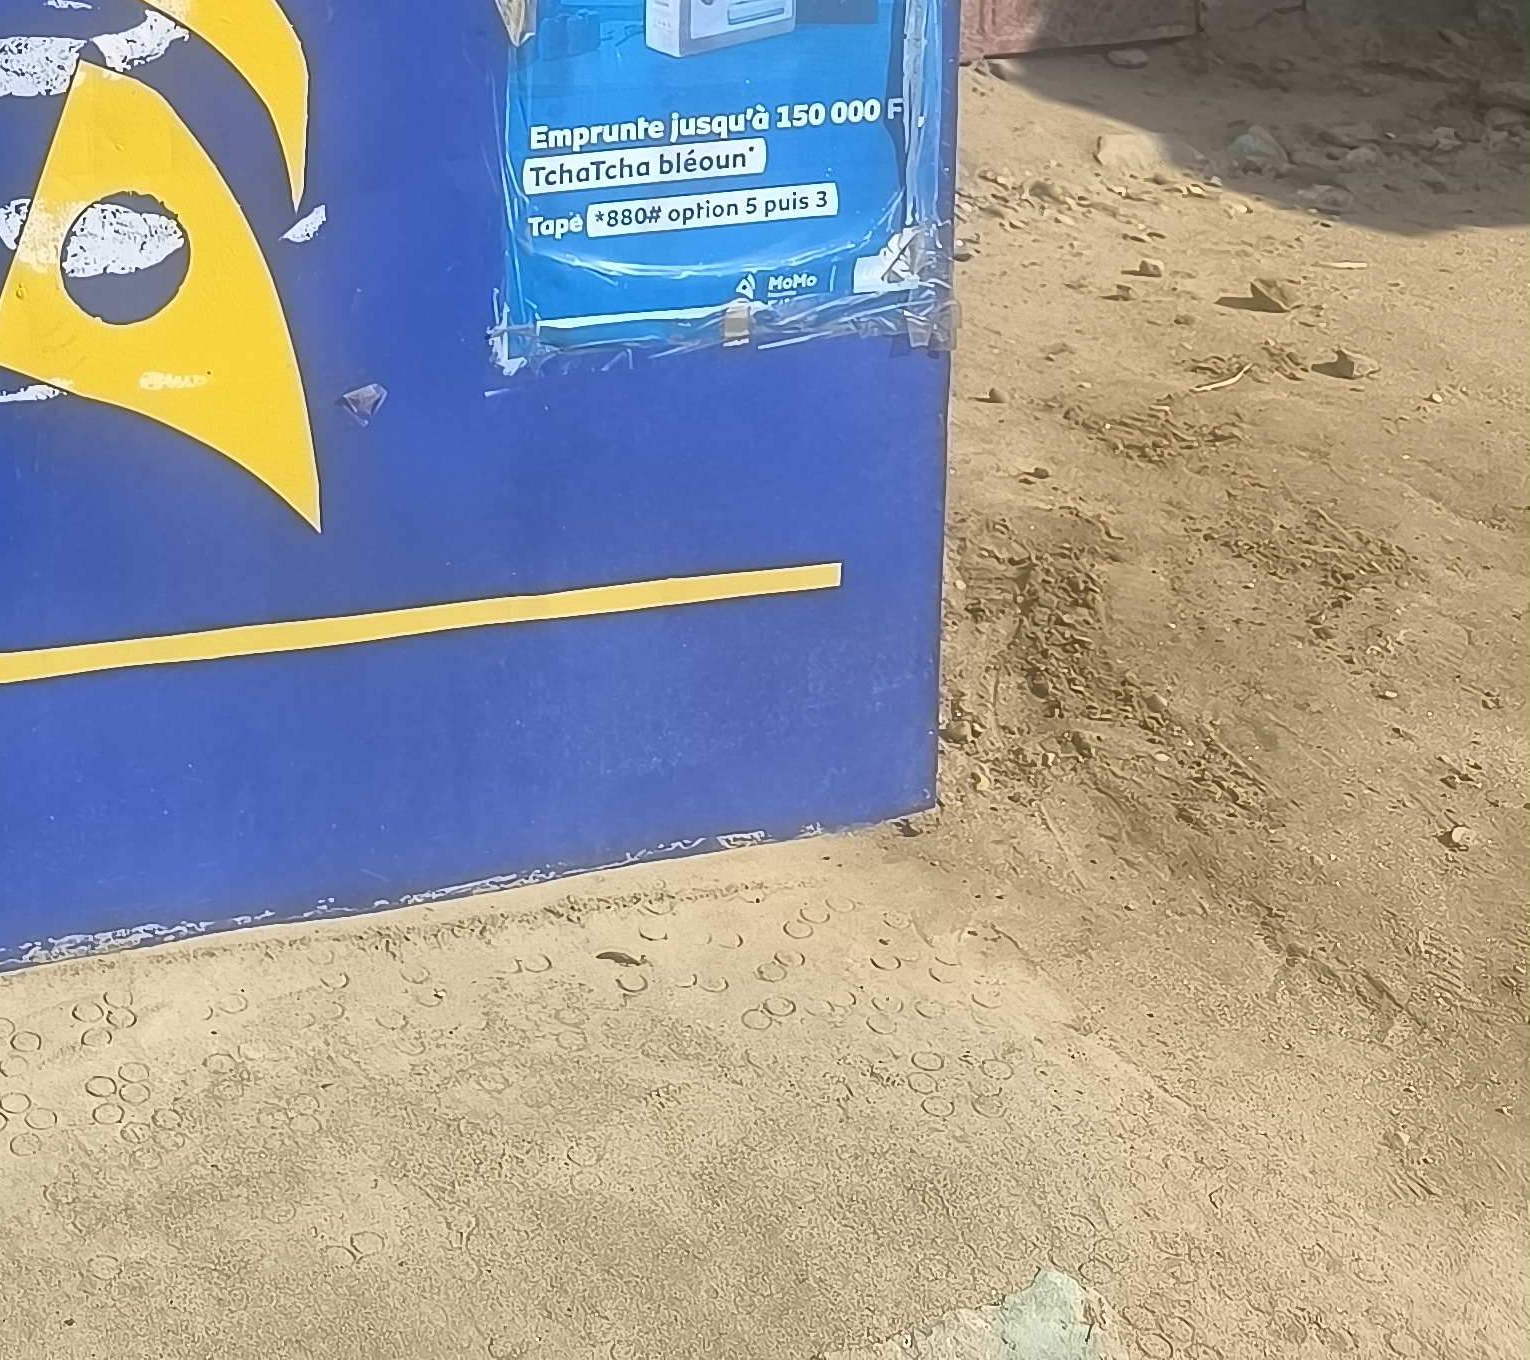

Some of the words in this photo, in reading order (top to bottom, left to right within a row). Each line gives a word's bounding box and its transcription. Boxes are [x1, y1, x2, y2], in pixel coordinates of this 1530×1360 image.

[530, 116, 665, 152] Emprunte
[670, 104, 769, 143] jusqu'à
[776, 102, 826, 129] 150
[830, 99, 881, 124] 000
[529, 157, 650, 187] TchaTcha
[668, 199, 739, 226] option
[745, 197, 757, 215] 5
[764, 191, 809, 218] puis
[816, 190, 828, 208] 3
[769, 273, 818, 290] MoMo
